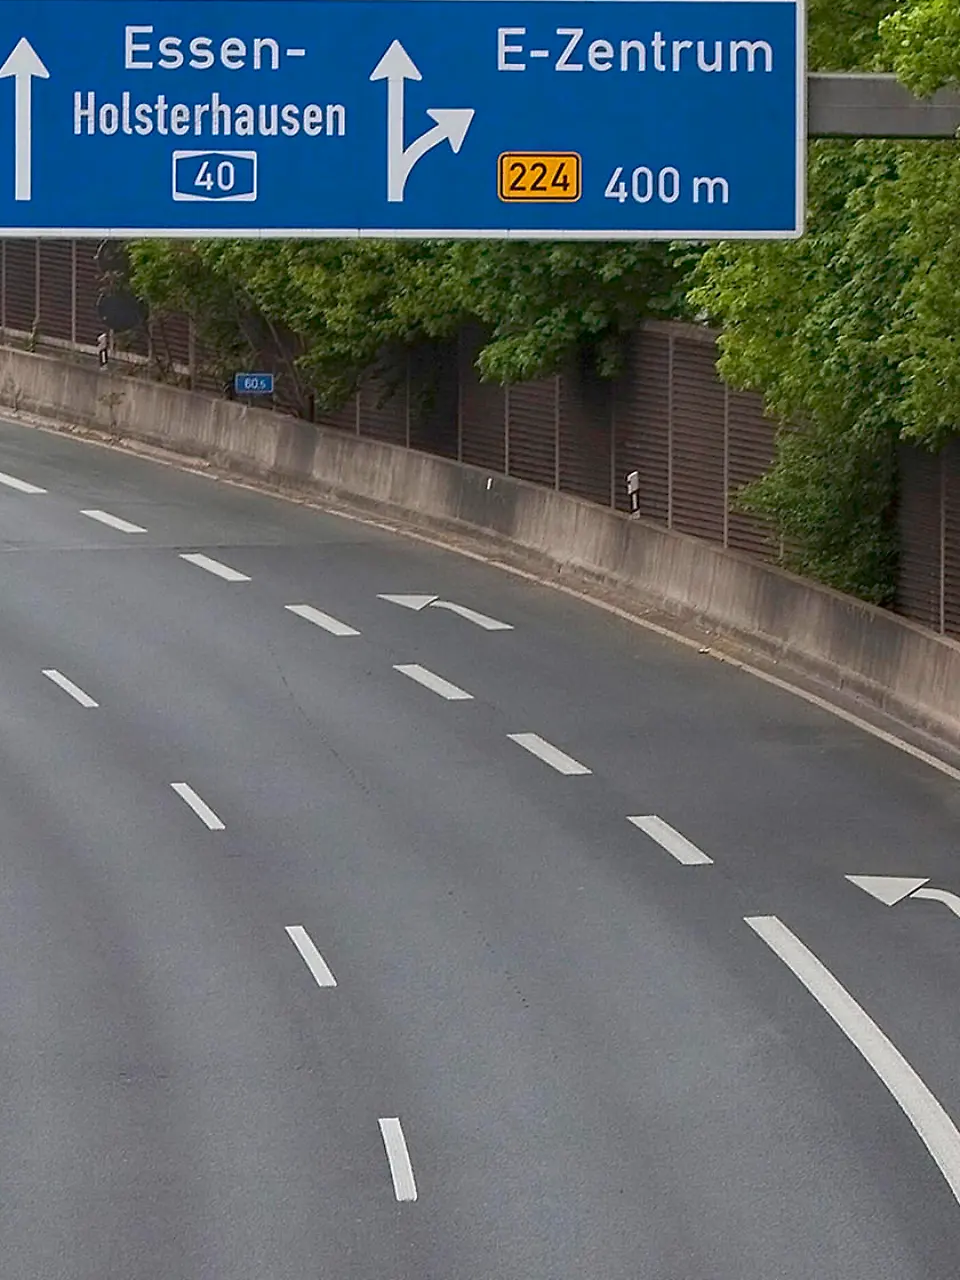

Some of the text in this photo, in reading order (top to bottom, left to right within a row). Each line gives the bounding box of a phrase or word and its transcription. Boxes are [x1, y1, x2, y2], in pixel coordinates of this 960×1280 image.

[125, 25, 306, 70] Essen-
[497, 27, 773, 72] E-Zentrum
[73, 91, 346, 136] Holsterhausen
[194, 161, 235, 191] 40
[509, 162, 570, 192] 224
[604, 166, 729, 203] 400 m
